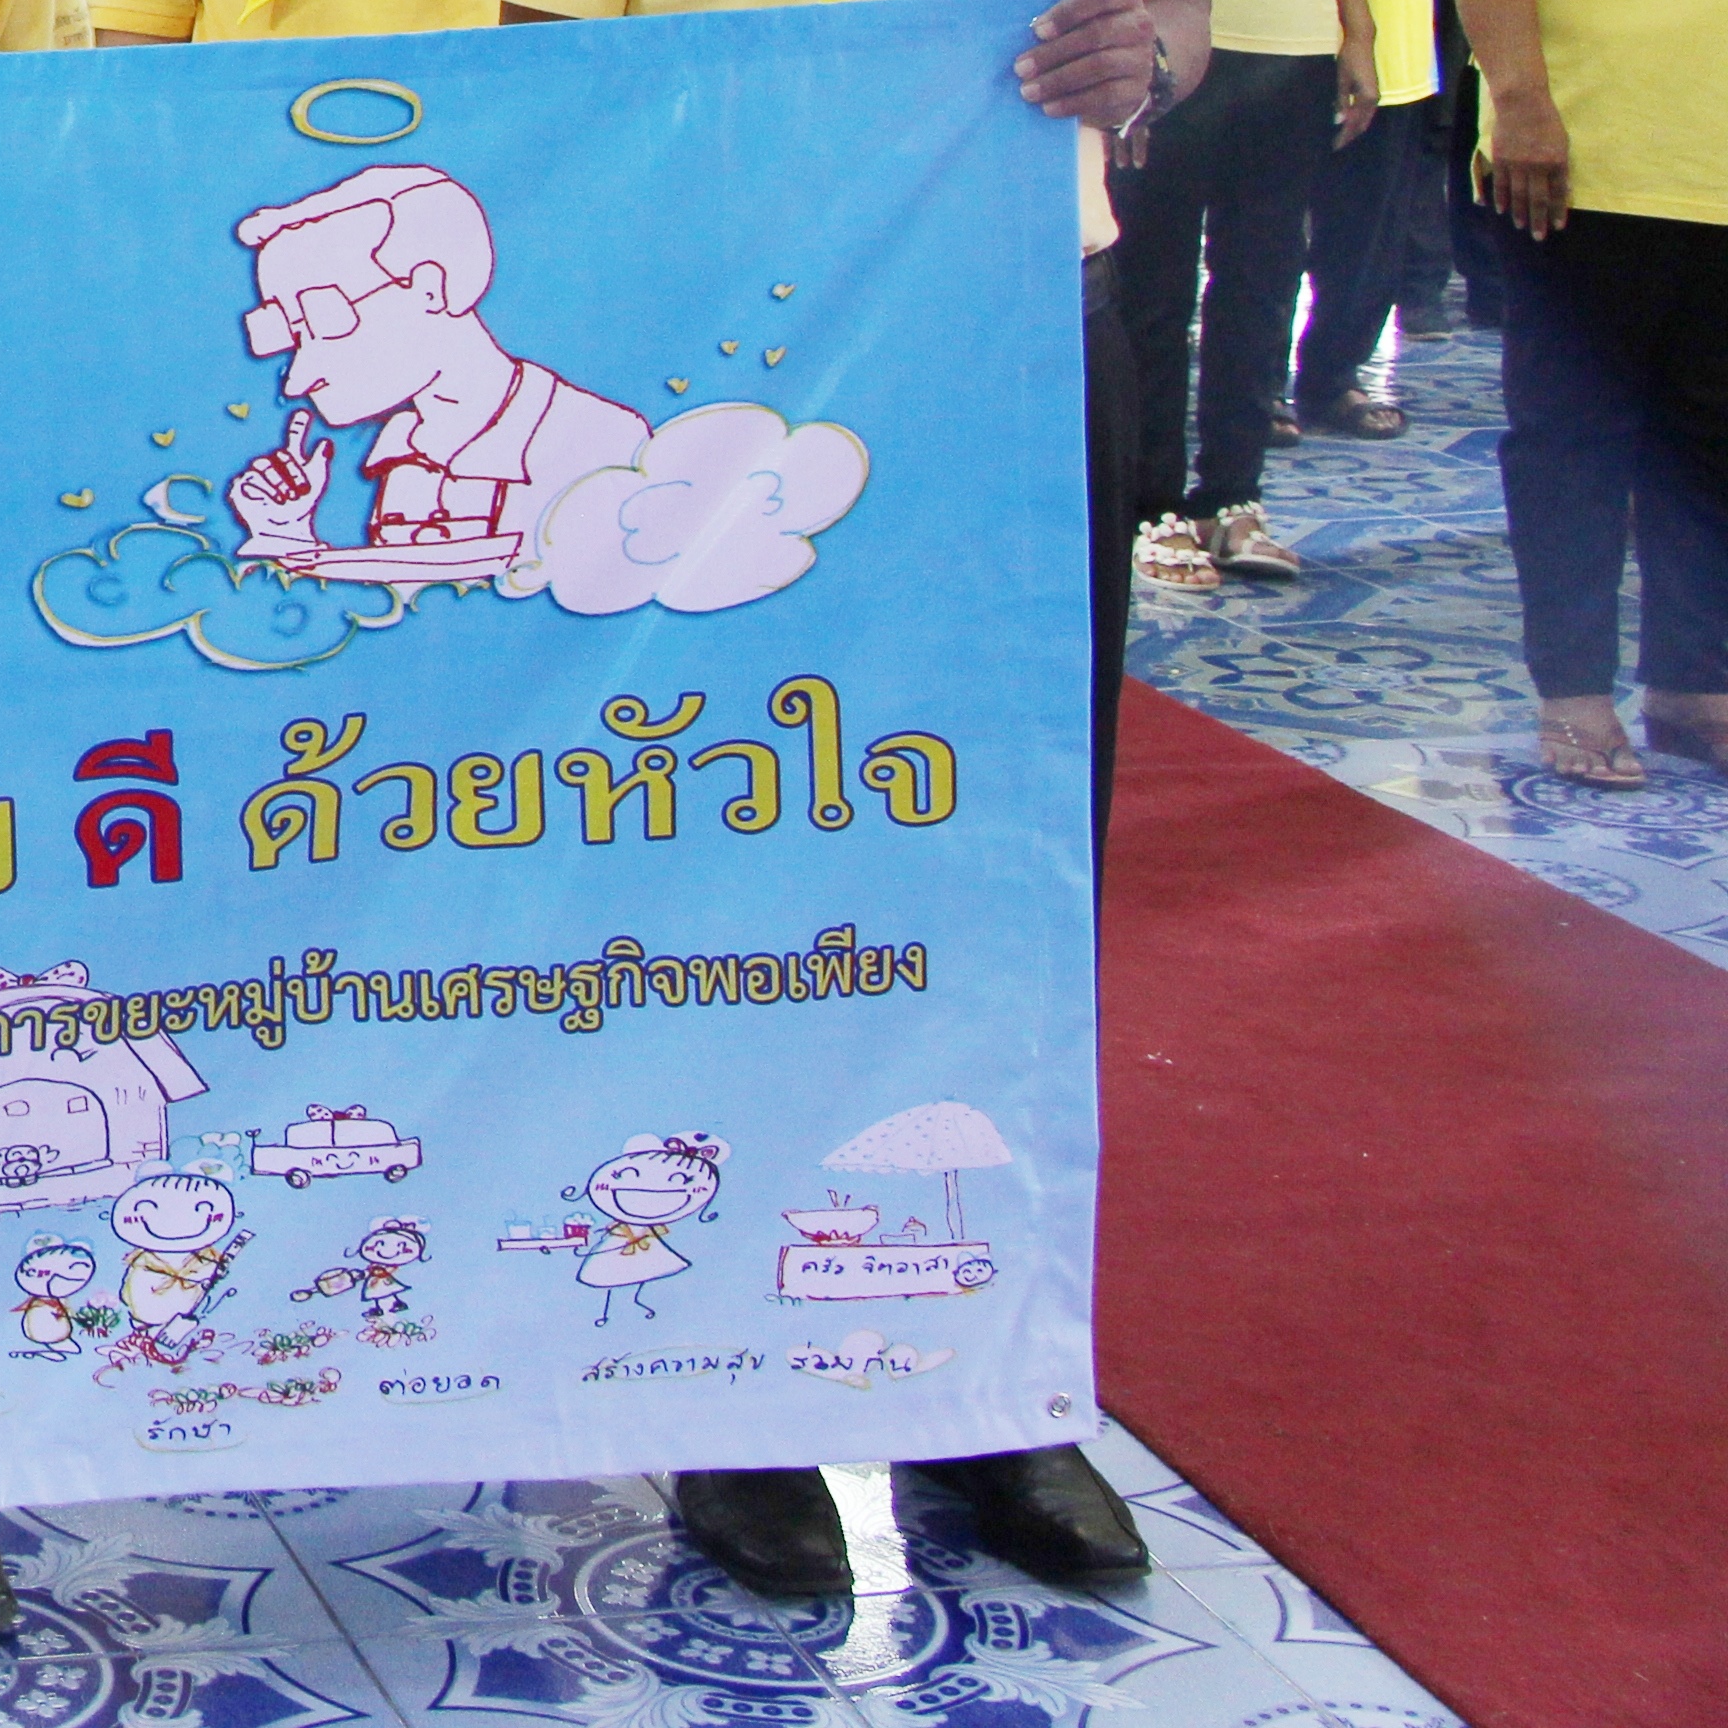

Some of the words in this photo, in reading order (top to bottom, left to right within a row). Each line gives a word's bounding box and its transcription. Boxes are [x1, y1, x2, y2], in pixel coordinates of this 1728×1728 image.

[74, 730, 184, 888] ดี
[239, 674, 958, 872] ด้วยหัวใจ
[378, 1371, 502, 1397] ต่อยอด
[146, 1418, 234, 1443] รักษา
